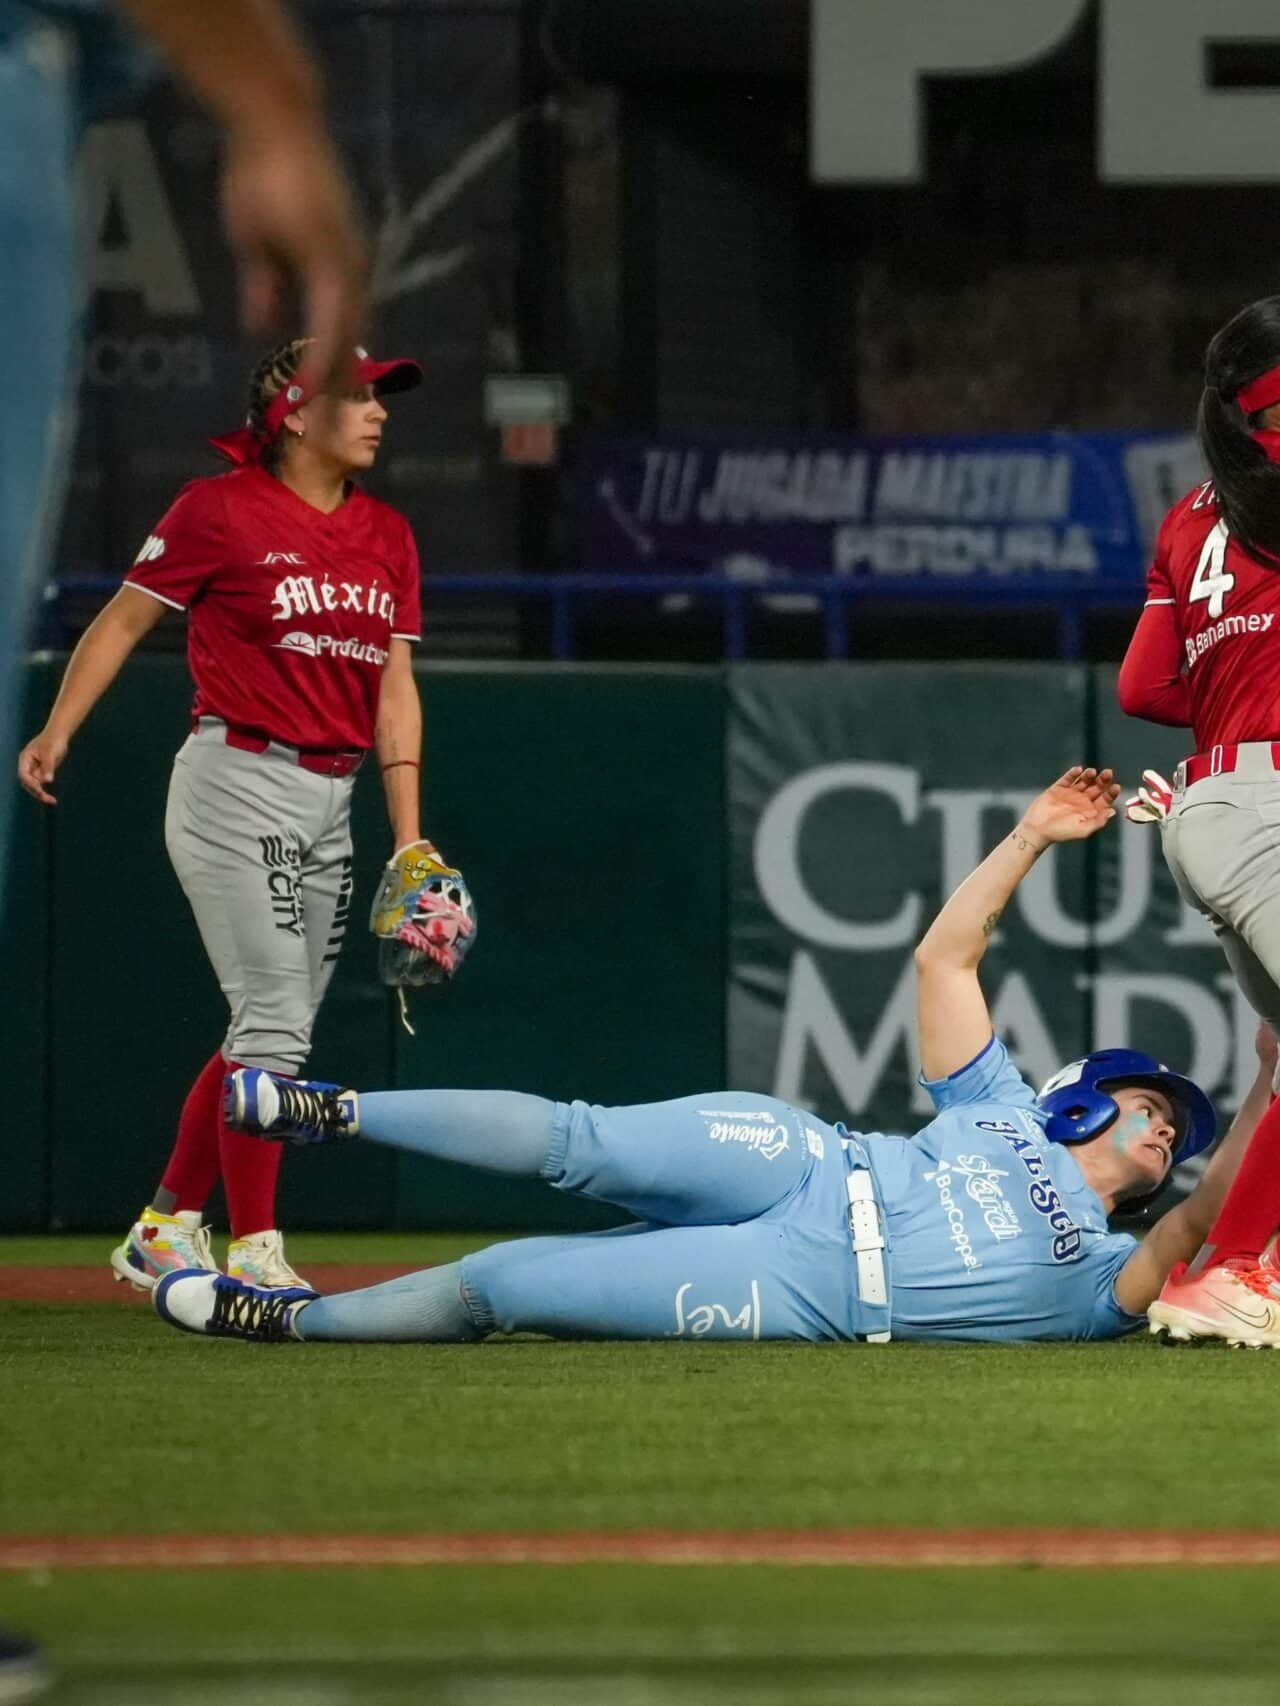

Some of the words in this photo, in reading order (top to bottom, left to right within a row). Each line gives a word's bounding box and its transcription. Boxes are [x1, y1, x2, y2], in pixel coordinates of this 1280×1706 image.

[698, 450, 869, 522] JUGADA
[872, 452, 1071, 519] MAESTRA
[833, 524, 1097, 575] PERDURA
[1189, 516, 1235, 619] 4
[272, 573, 395, 628] Méxic
[1196, 612, 1275, 656] Banamex
[267, 870, 305, 938] CITY
[935, 1172, 985, 1276] BanCoppel
[974, 1119, 1083, 1264] JALISCO
